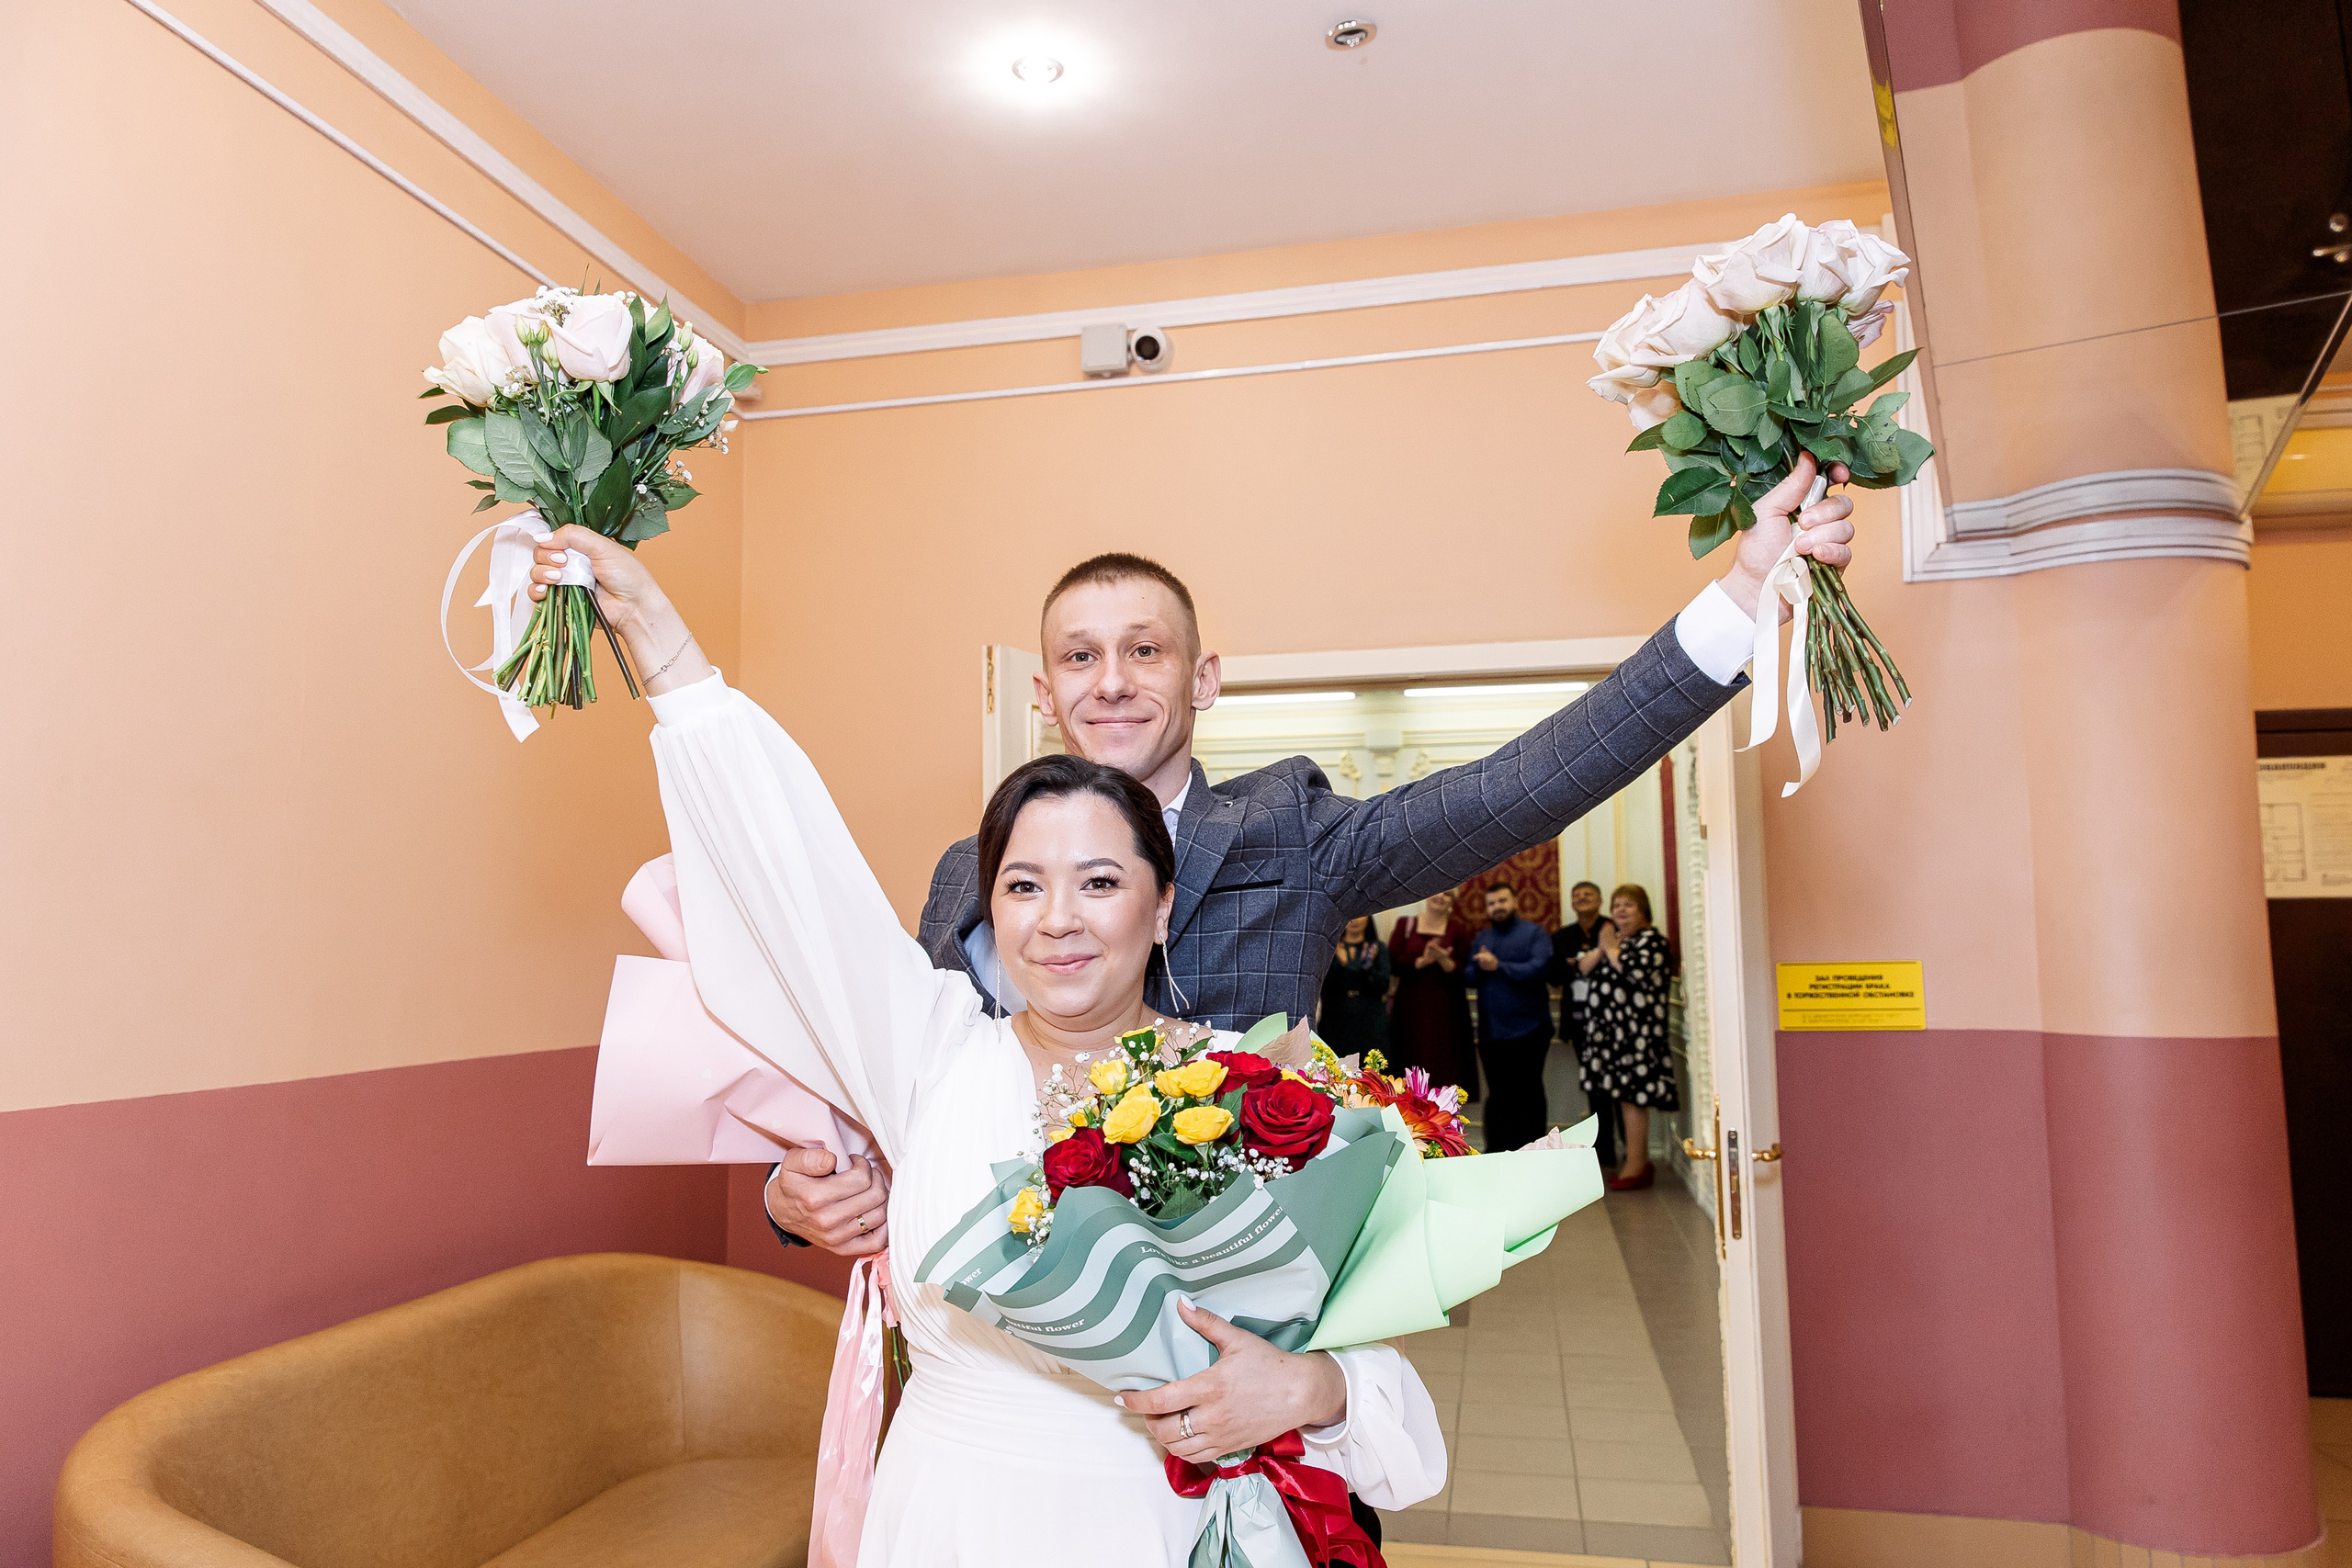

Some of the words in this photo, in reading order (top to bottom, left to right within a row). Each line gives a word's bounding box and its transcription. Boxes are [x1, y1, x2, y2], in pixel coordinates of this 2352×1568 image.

[1139, 1246, 1167, 1259] Love
[1201, 1233, 1253, 1261] beautiful
[1045, 1318, 1085, 1333] flower
